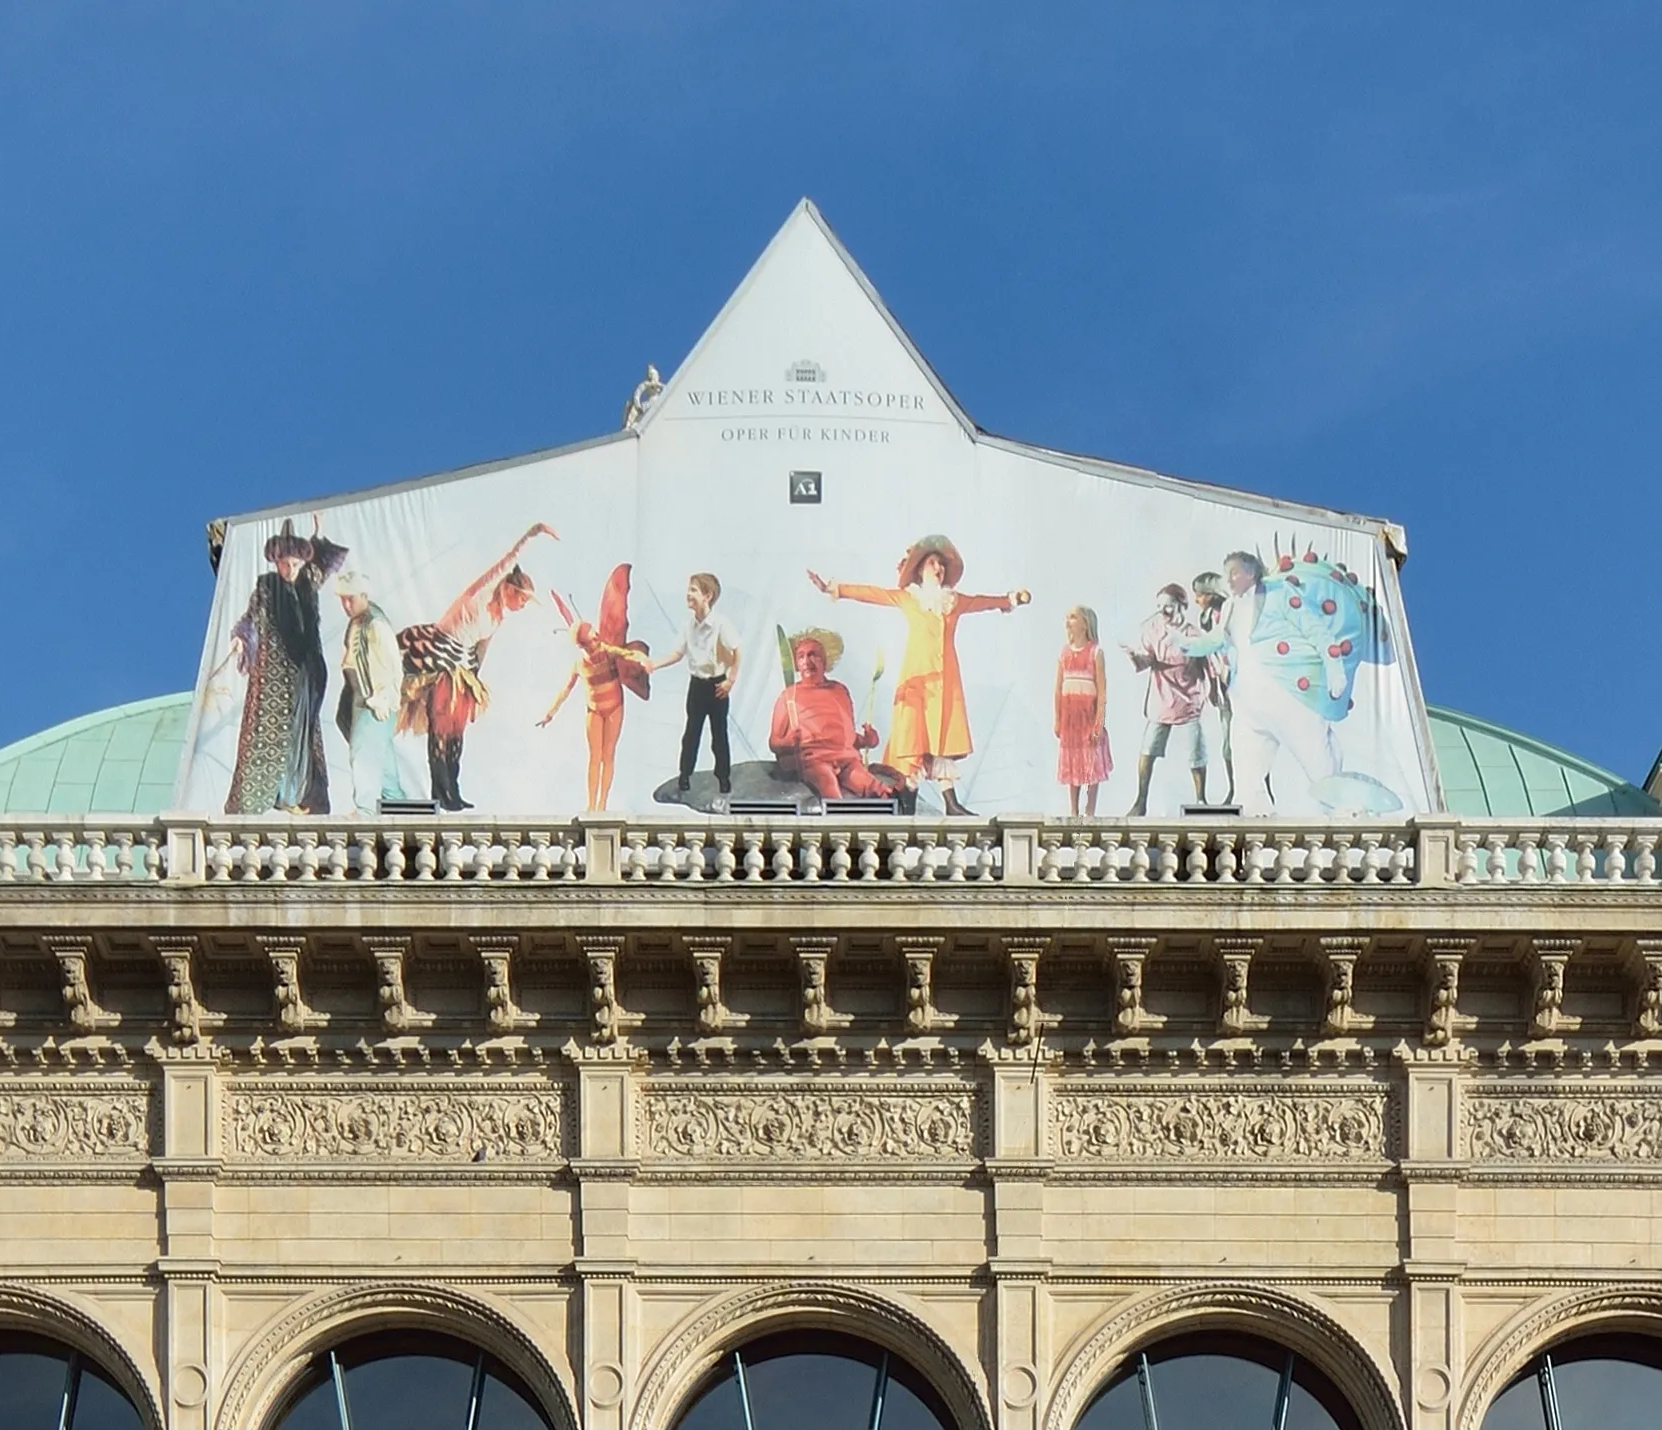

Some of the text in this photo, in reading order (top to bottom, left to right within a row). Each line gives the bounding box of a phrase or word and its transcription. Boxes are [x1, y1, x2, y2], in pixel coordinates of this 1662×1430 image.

[687, 388, 926, 410] WIENER STAATSOPER
[721, 425, 891, 444] OPER FÜR KINDER
[794, 481, 818, 496] A1
